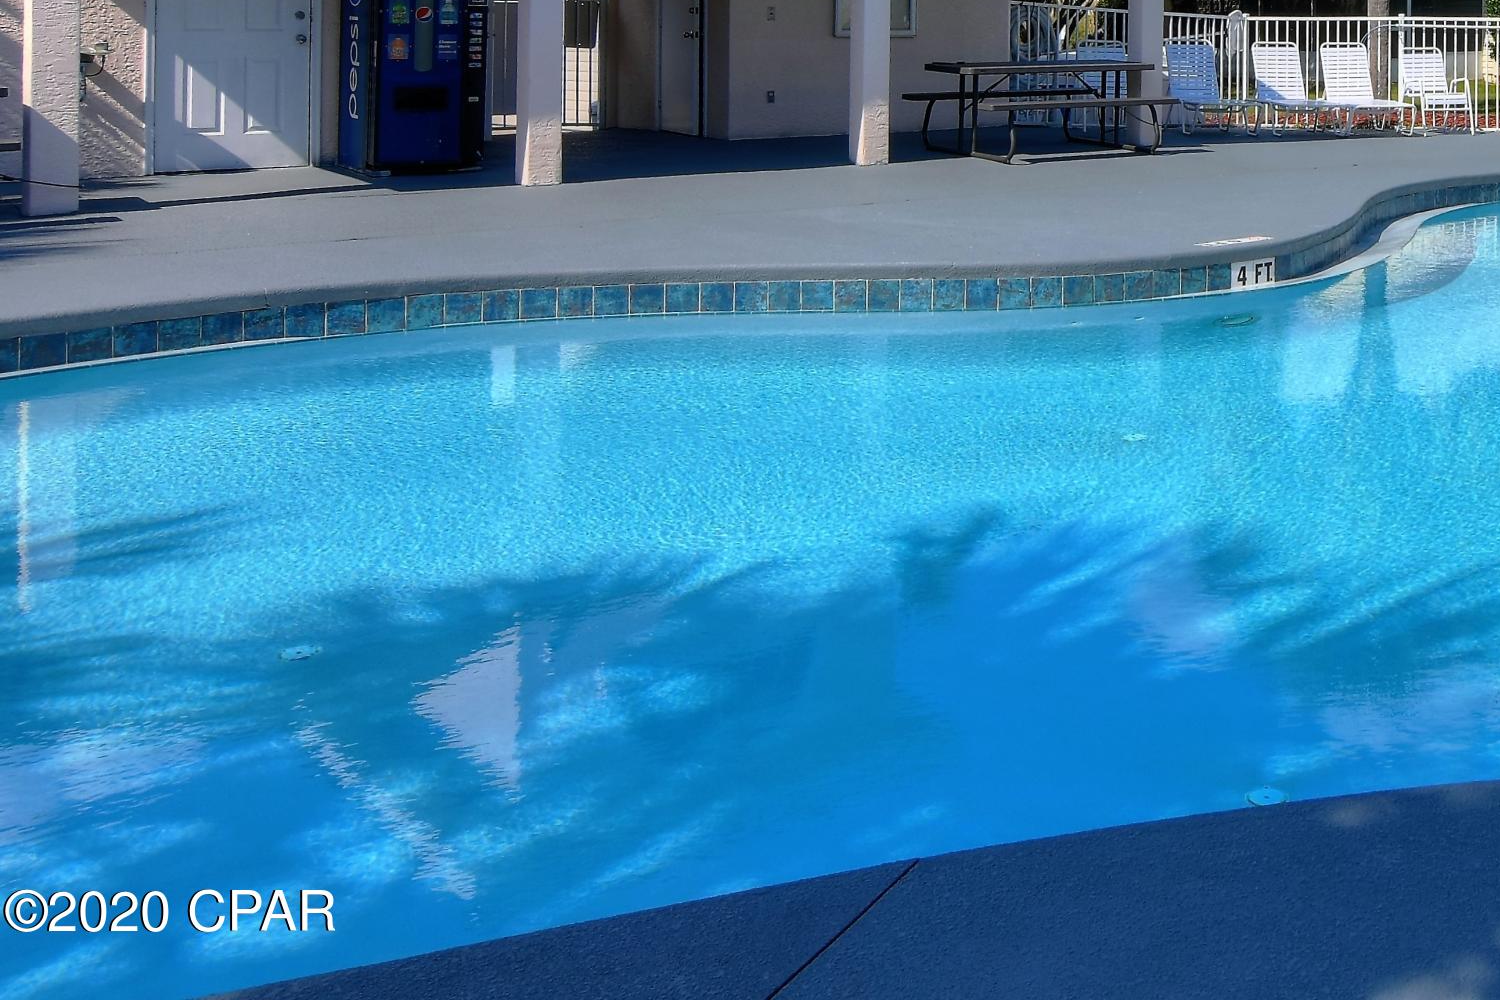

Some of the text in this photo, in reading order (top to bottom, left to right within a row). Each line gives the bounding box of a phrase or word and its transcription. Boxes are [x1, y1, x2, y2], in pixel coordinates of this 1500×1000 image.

[348, 15, 360, 120] pepsi
[1237, 262, 1273, 286] 4 FT.
